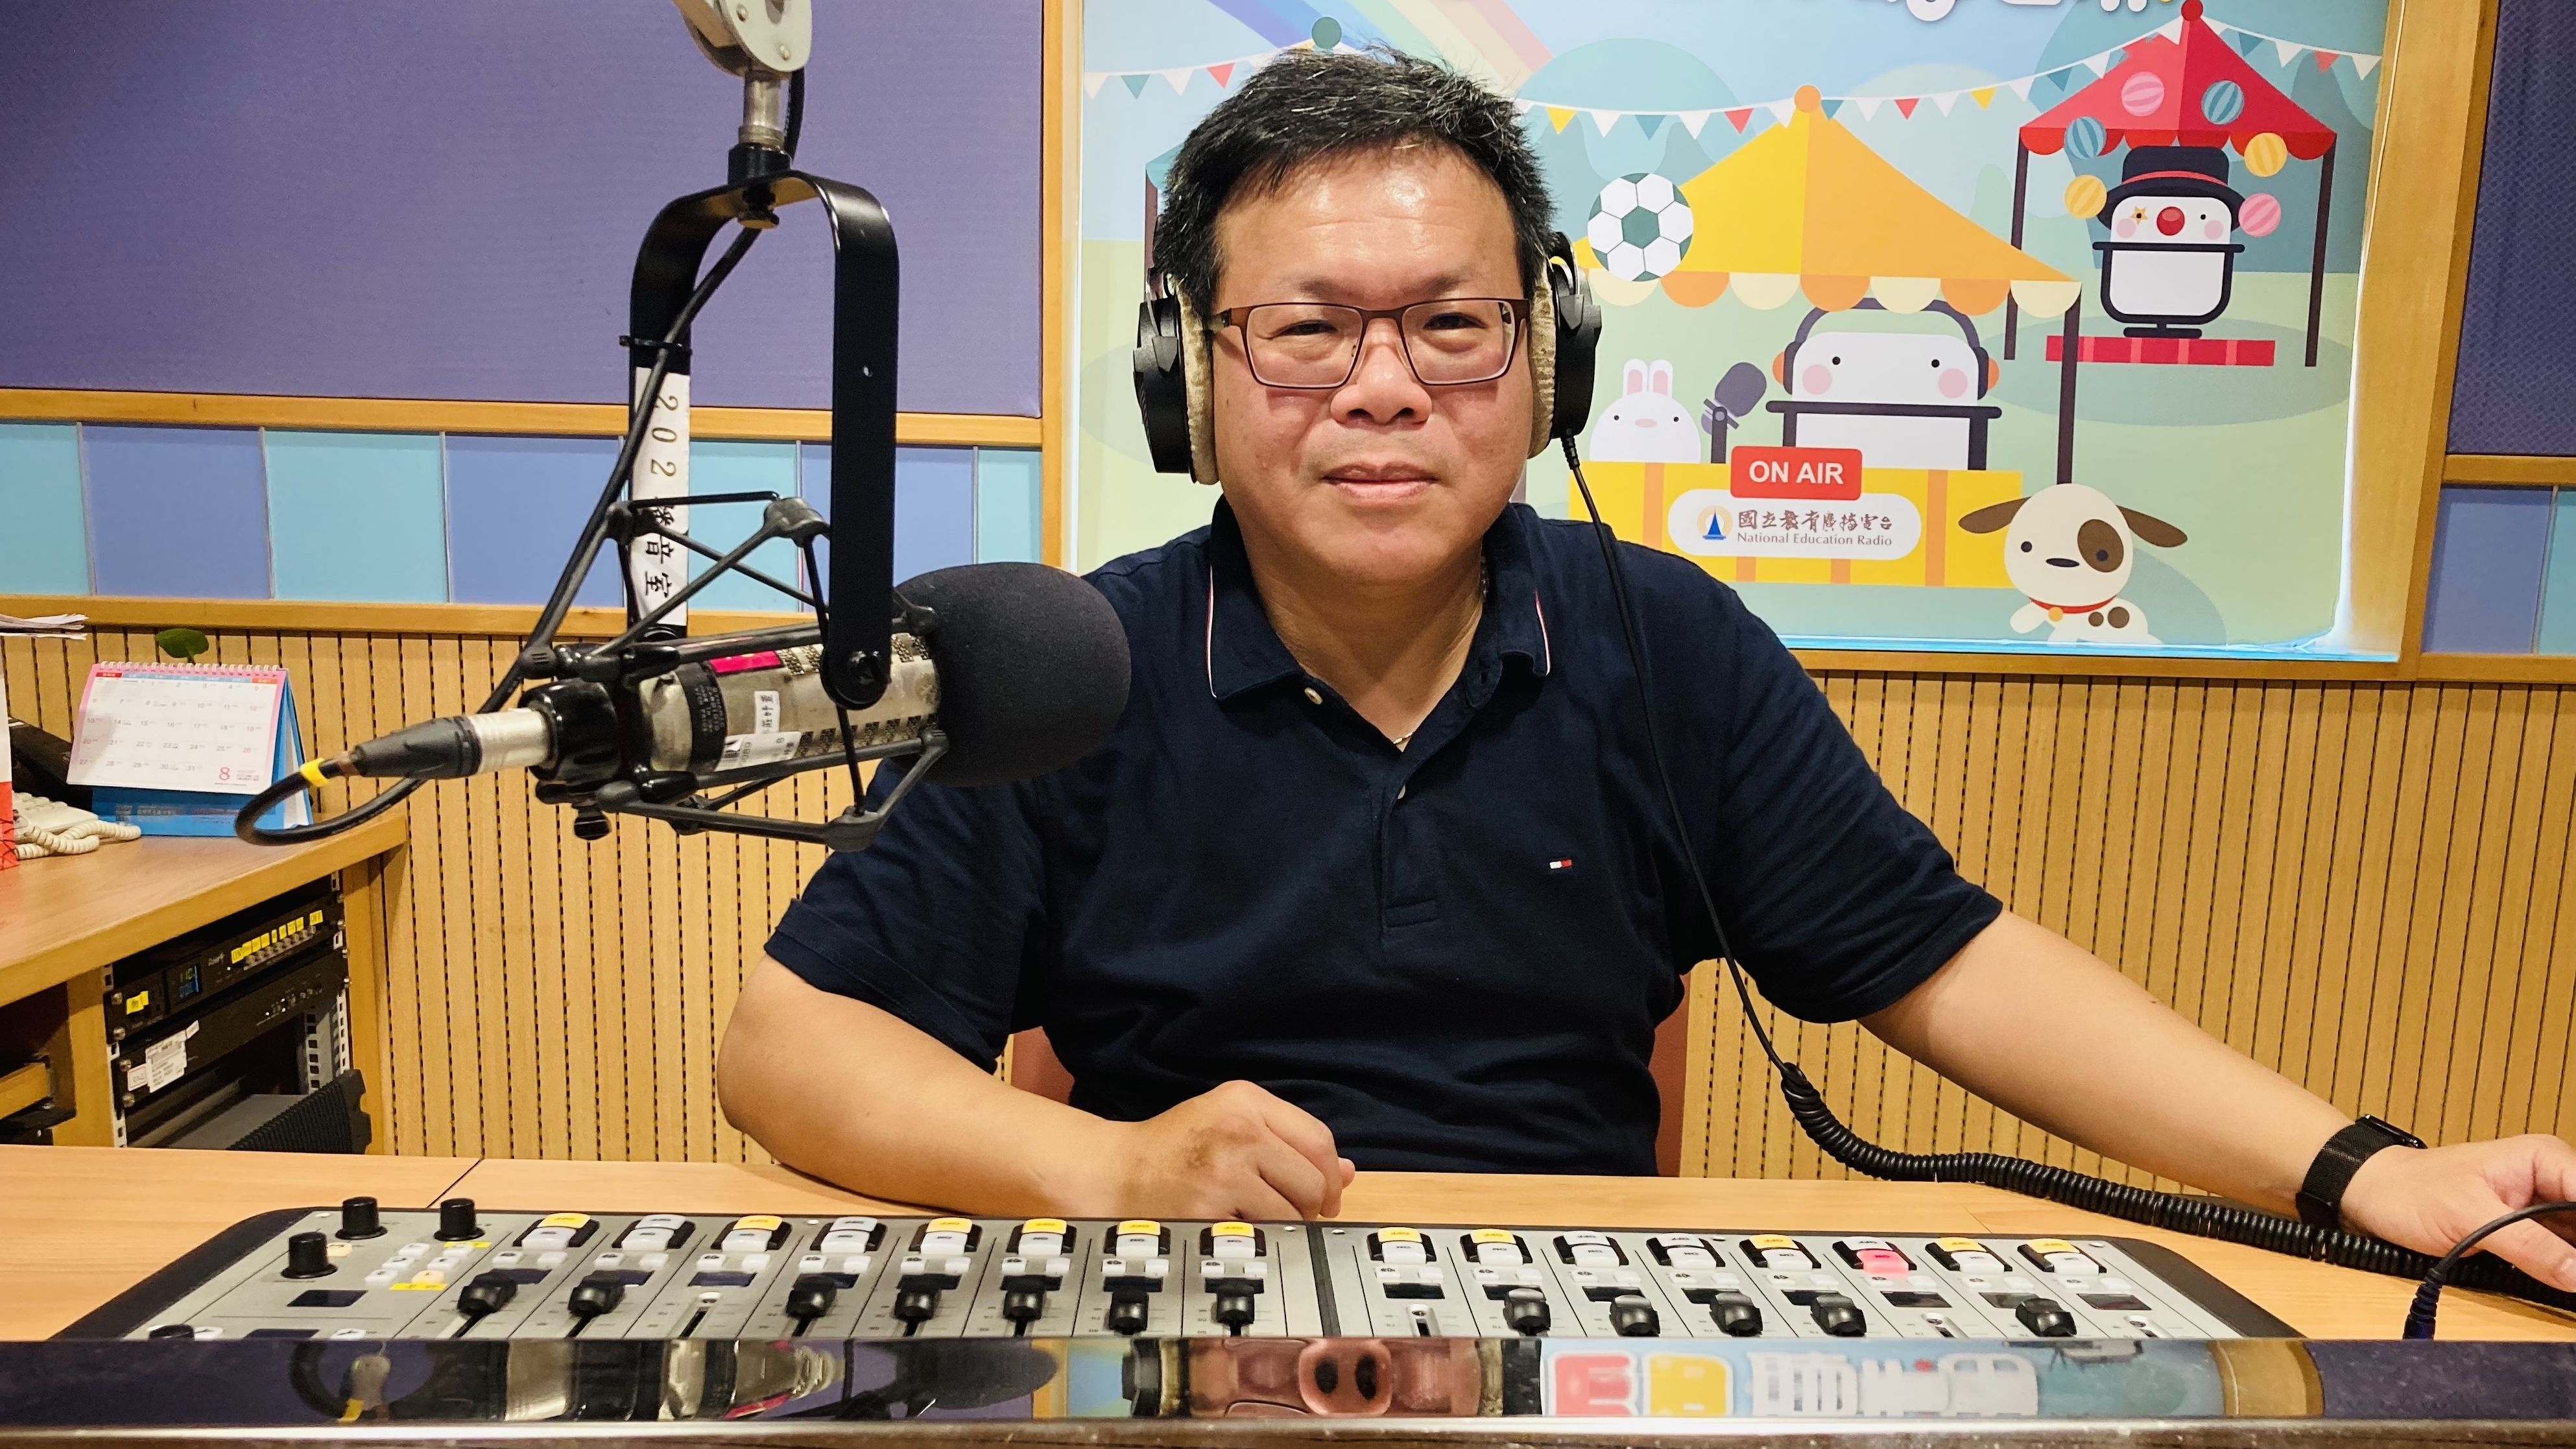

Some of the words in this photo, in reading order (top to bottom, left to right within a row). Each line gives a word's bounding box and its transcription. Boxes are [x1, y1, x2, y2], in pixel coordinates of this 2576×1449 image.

[650, 396, 679, 476] 202
[1749, 461, 1789, 483] ON
[1796, 462, 1844, 485] AIR
[1738, 510, 1892, 533] 國立教育廣播電台
[1737, 533, 1789, 543] National
[1793, 533, 1853, 544] Education
[1857, 534, 1892, 545] Radio
[219, 767, 230, 781] 8
